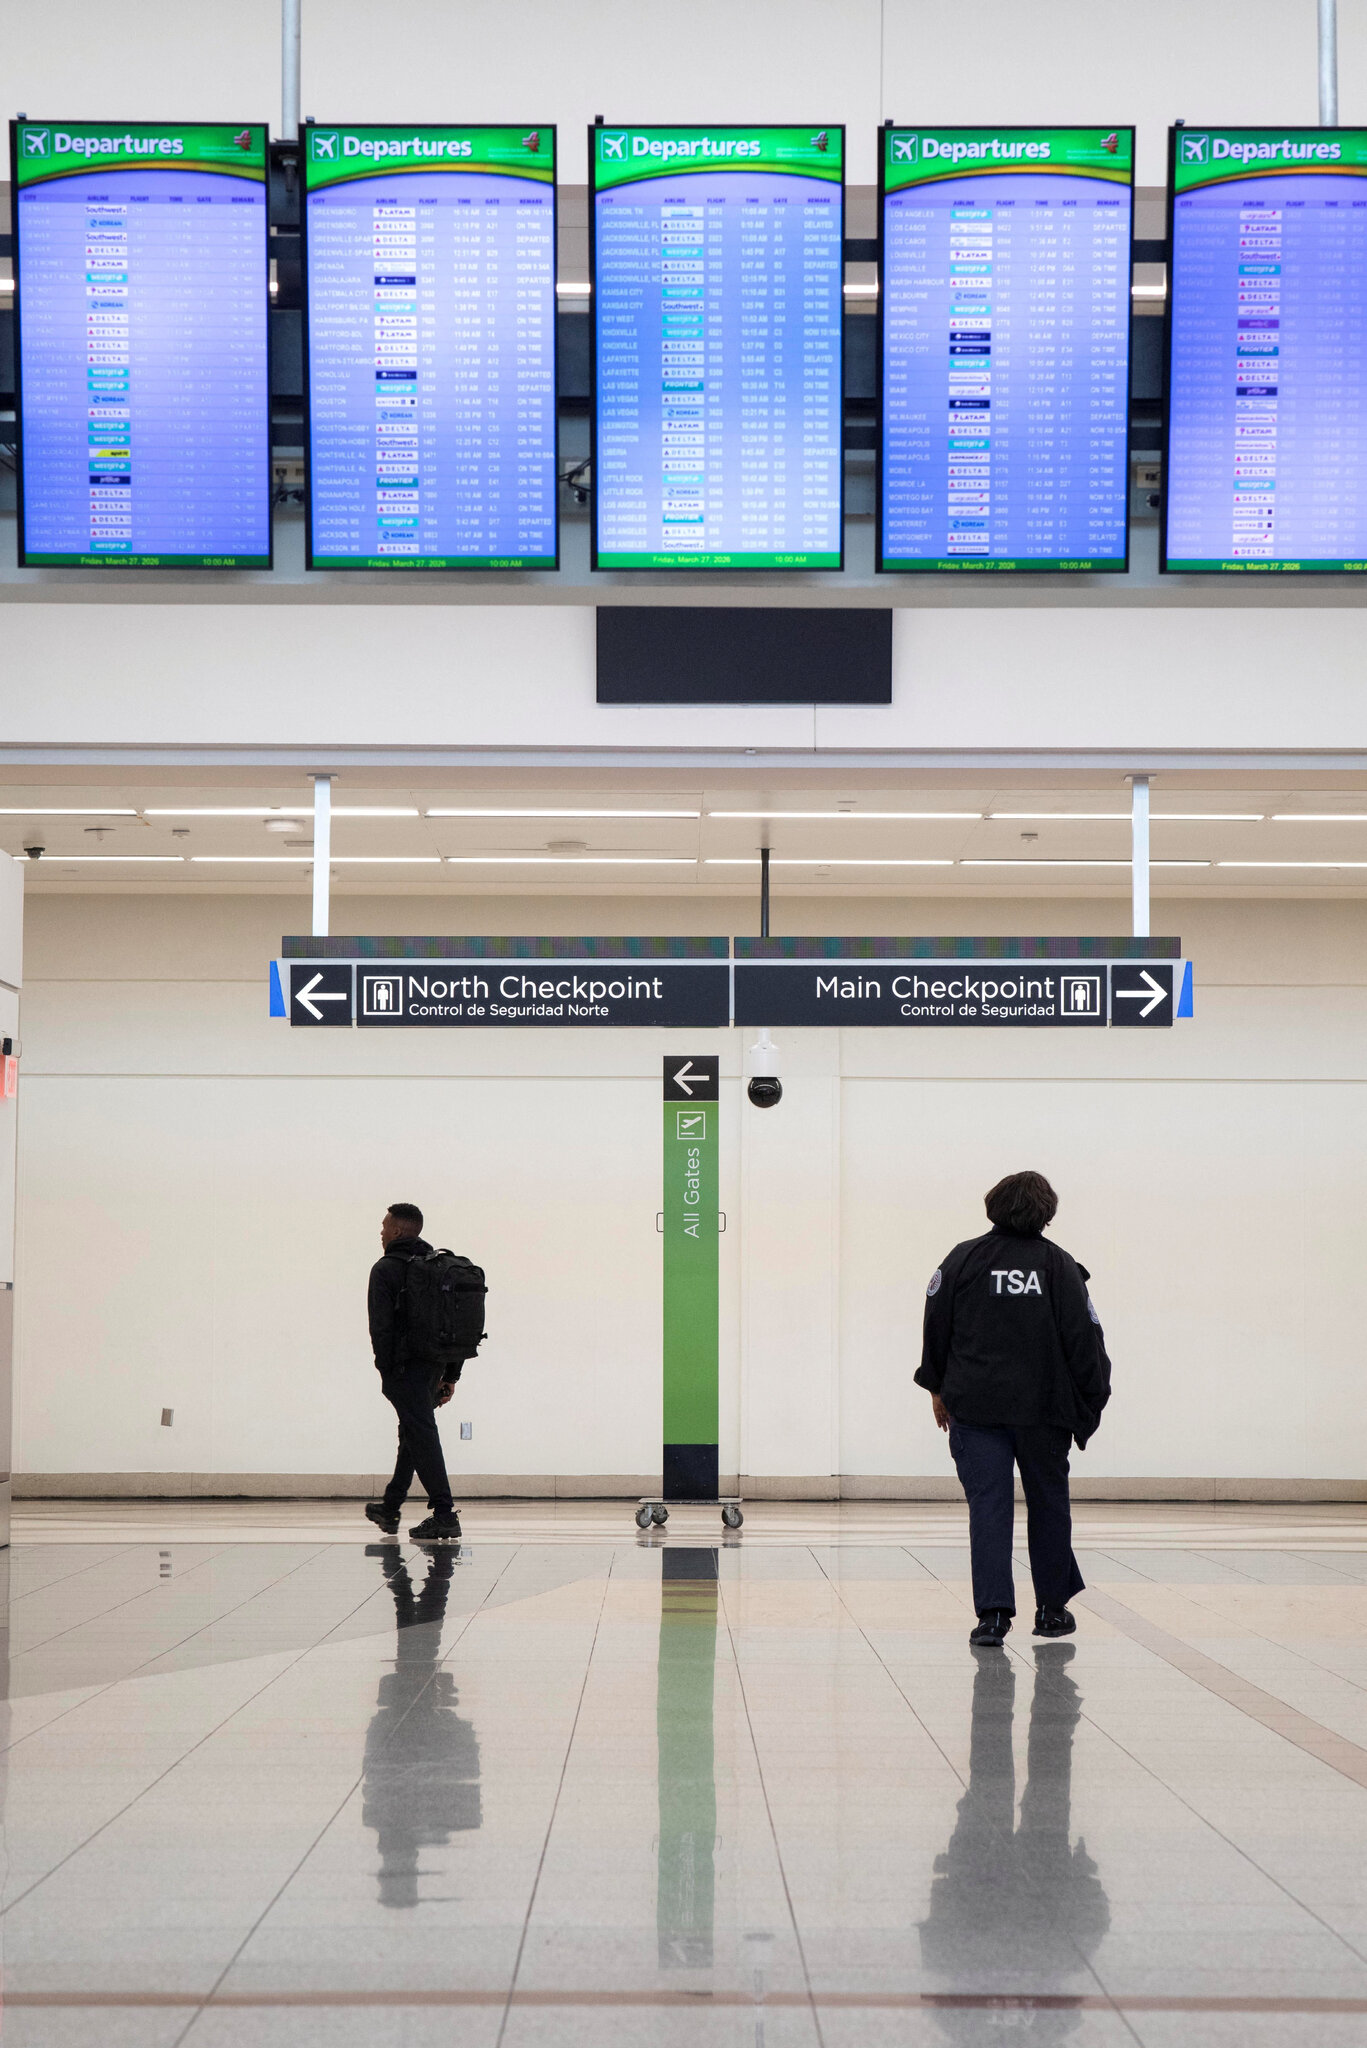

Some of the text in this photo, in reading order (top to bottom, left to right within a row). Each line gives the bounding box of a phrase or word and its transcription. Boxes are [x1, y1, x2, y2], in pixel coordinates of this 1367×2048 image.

[55, 132, 183, 158] Departures
[344, 136, 472, 161] Departures
[632, 136, 760, 160] Departures
[922, 137, 1050, 162] Departures
[1213, 138, 1342, 164] Departures
[408, 975, 663, 1005] North Checkpoint
[816, 975, 1055, 1005] Main Checkpoint
[409, 1004, 609, 1020] Control de Seguridad Norte
[900, 1004, 1055, 1020] Control de Seguridad
[683, 1147, 700, 1239] All Gates
[991, 1270, 1042, 1295] TSA
